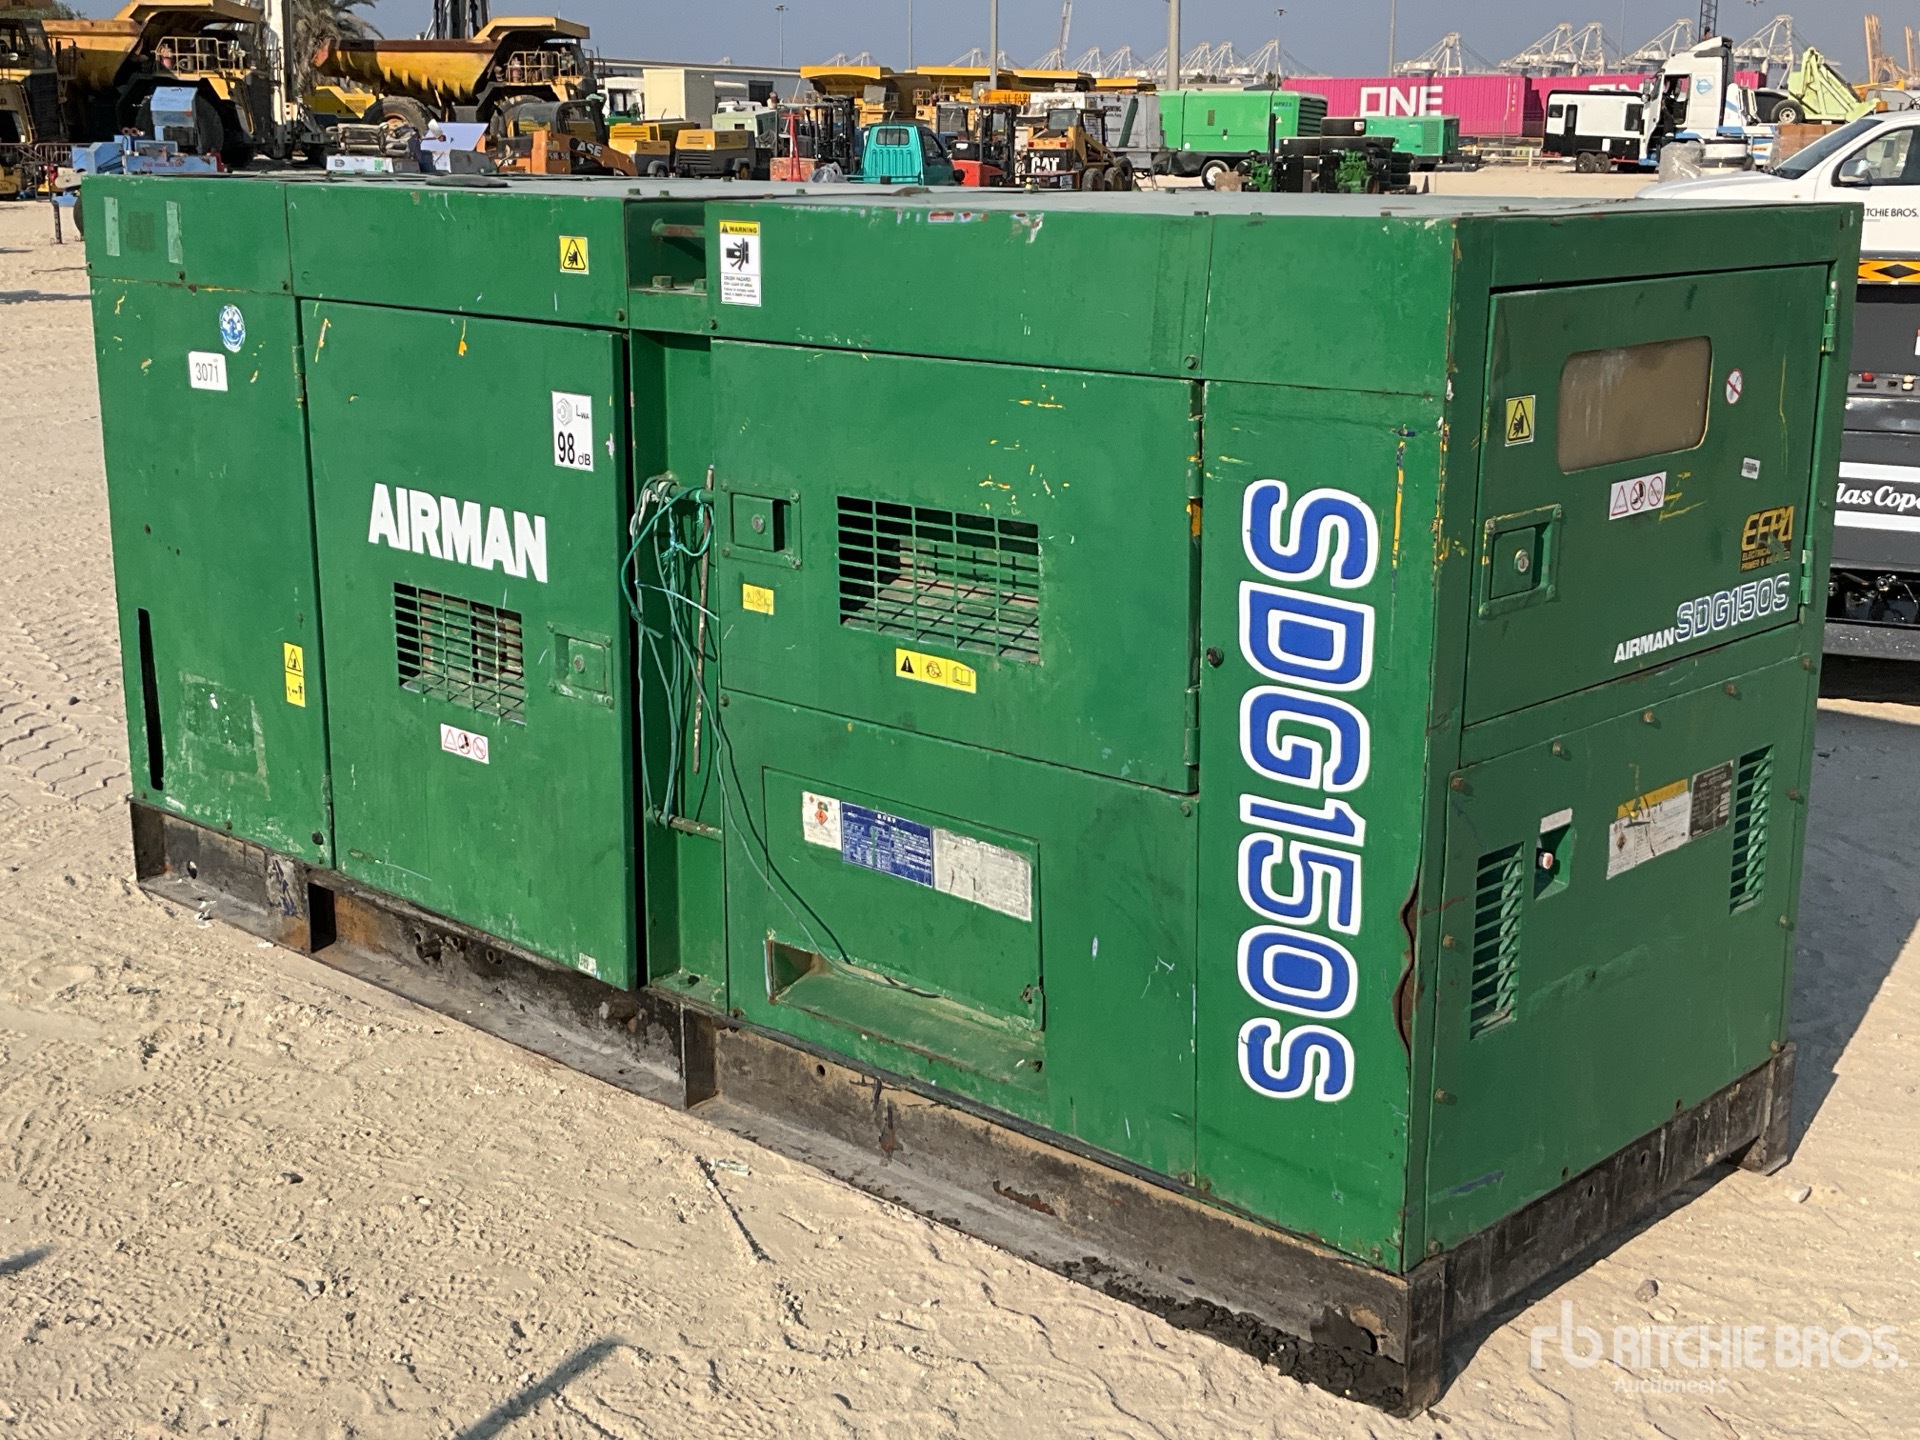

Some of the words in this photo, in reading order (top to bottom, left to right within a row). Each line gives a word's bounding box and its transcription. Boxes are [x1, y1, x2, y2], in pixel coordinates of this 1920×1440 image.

[1360, 86, 1443, 116] ONE
[577, 141, 602, 157] ASE
[1031, 157, 1060, 173] CAT
[1864, 208, 1890, 217] TCHIE
[1890, 208, 1919, 217] BROS.
[729, 225, 758, 234] WARNING
[195, 362, 219, 383] 3071
[557, 431, 575, 464] 98
[577, 452, 591, 466] dB
[1836, 482, 1871, 505] las
[368, 482, 548, 583] AIRMAN
[1614, 627, 1675, 664] AIRMAN
[1675, 573, 1790, 642] SDG150S
[1237, 478, 1379, 1104] SDG150S
